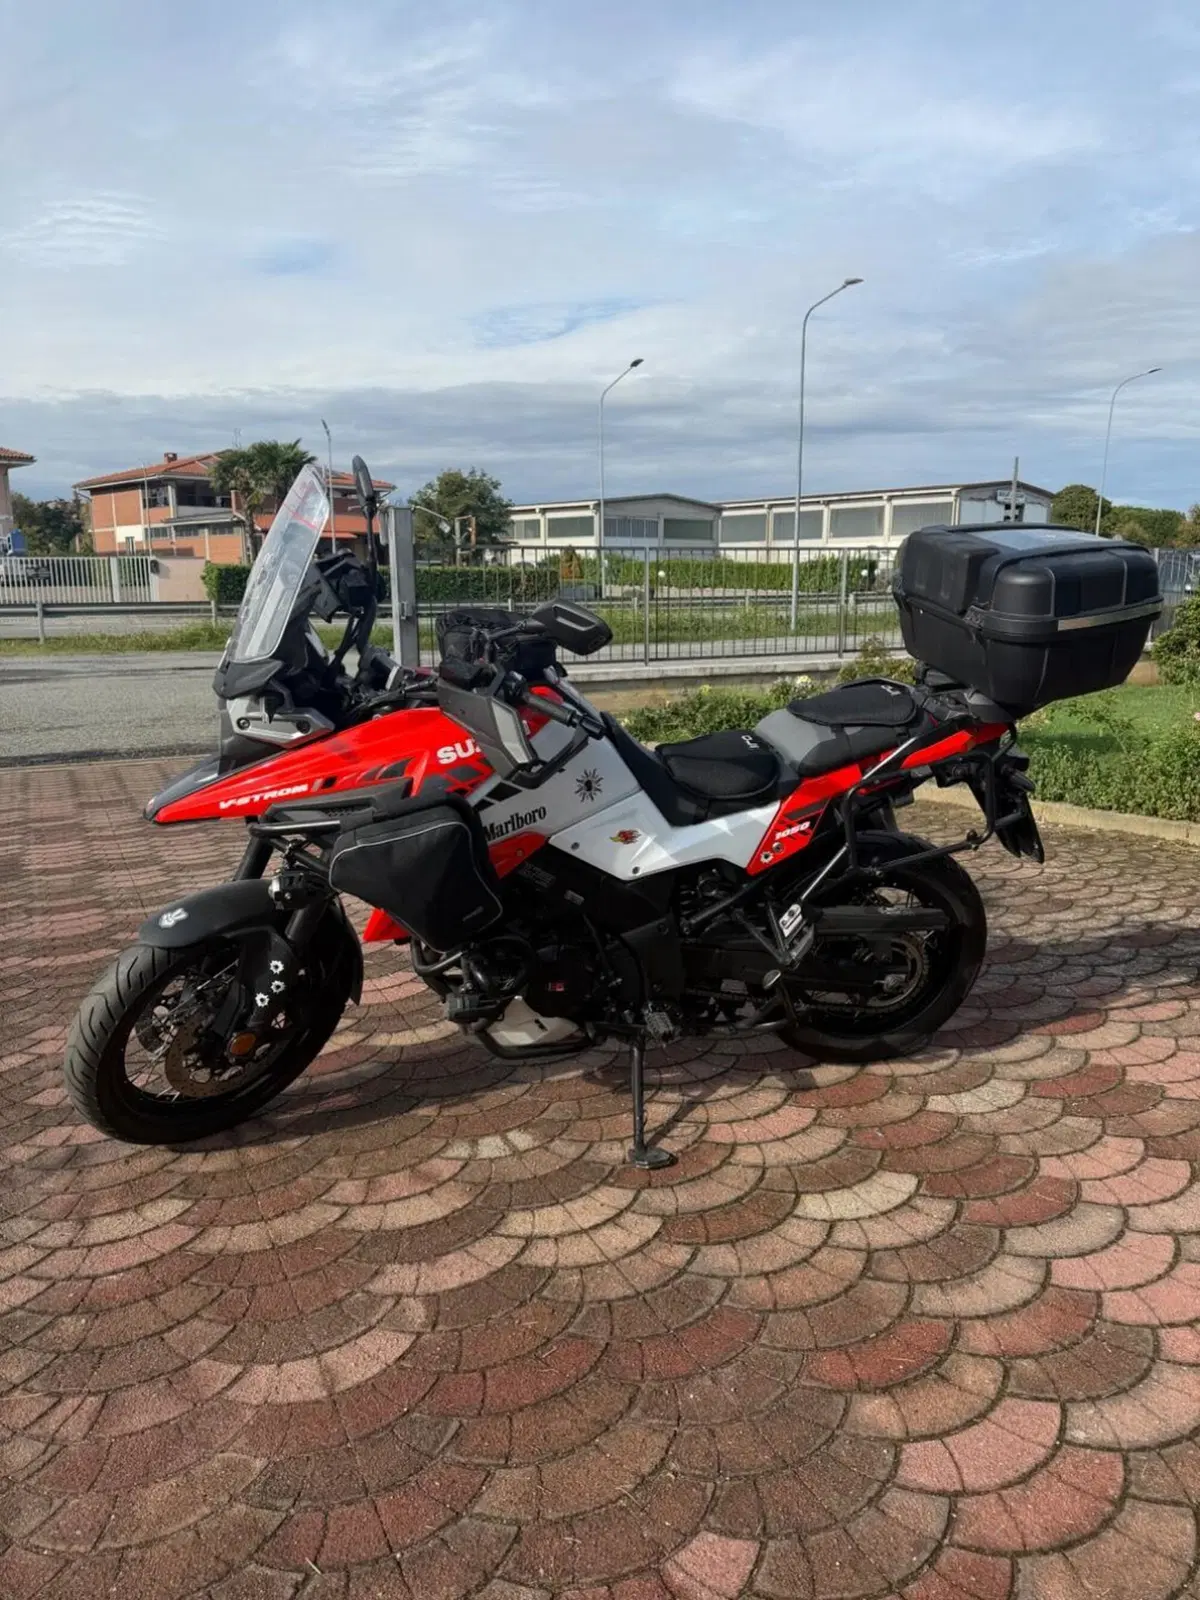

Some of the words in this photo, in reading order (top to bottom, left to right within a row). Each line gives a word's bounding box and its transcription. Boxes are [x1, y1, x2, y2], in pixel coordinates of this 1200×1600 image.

[437, 738, 481, 765] SU
[483, 806, 547, 841] Marlboro
[775, 821, 810, 840] 1050
